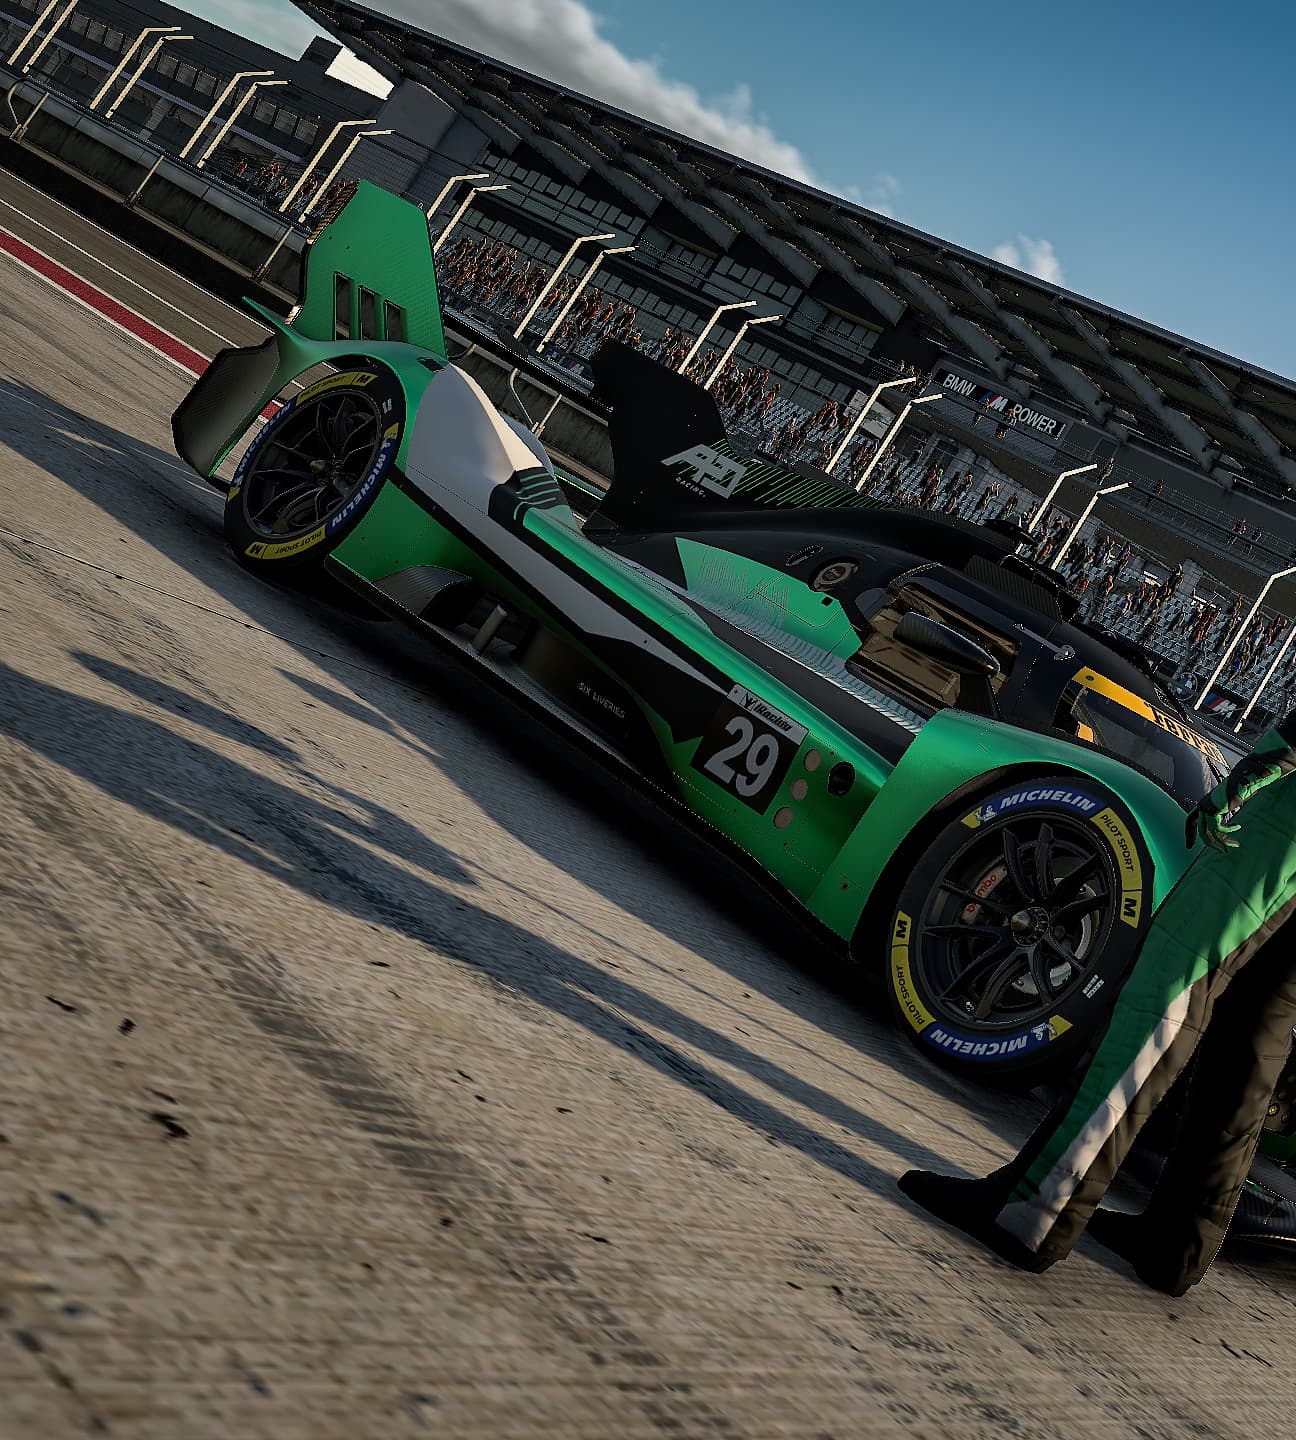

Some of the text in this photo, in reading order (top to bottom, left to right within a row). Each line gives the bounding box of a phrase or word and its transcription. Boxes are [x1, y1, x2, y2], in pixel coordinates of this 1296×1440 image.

[943, 373, 977, 397] BMW
[1013, 403, 1057, 434] POWER
[332, 452, 387, 528] MICHELIN
[250, 543, 263, 555] M
[274, 530, 323, 554] PILOT SPORT
[578, 681, 591, 696] SIX
[704, 715, 780, 798] 29
[1000, 789, 1096, 812] MICHELIN
[1100, 814, 1135, 872] PILOT SPORT
[965, 874, 998, 913] bmbo
[1123, 896, 1138, 918] M
[895, 919, 908, 939] M
[896, 964, 926, 1025] PILOT SPORT
[930, 1028, 1028, 1056] MICHELIN
